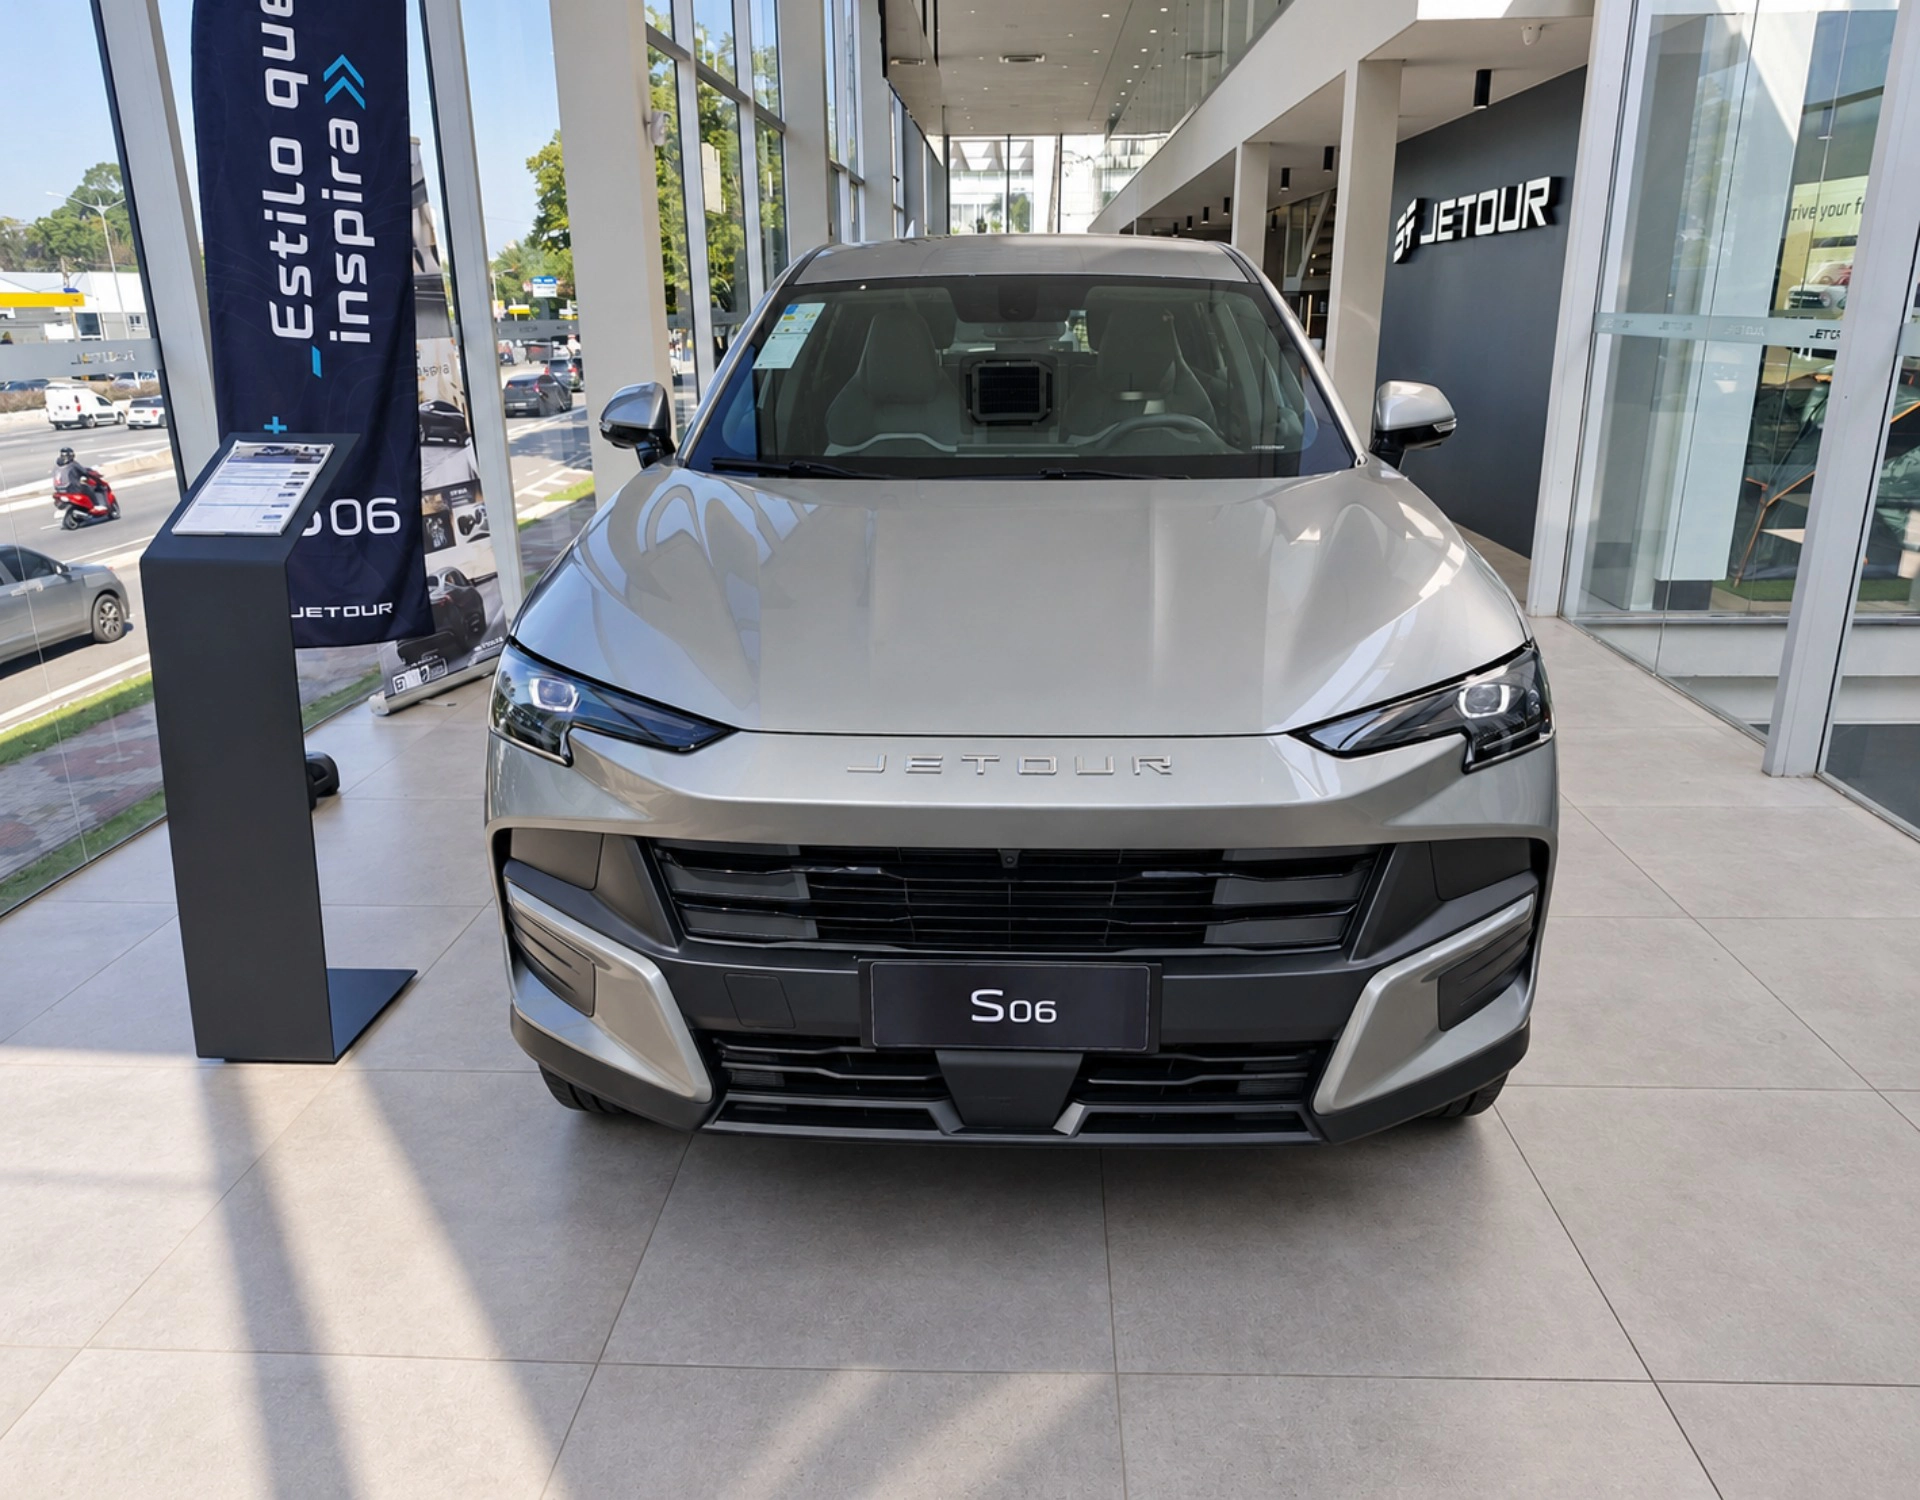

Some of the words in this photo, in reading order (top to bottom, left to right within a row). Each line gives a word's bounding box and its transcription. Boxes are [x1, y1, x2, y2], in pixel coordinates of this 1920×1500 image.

[1419, 176, 1551, 245] JETOUR
[1819, 202, 1853, 222] your
[262, 136, 315, 340] Estilo
[321, 118, 376, 343] inspira
[290, 602, 393, 618] JETOUR
[846, 753, 1173, 776] JETOUR
[969, 988, 1058, 1024] S06
